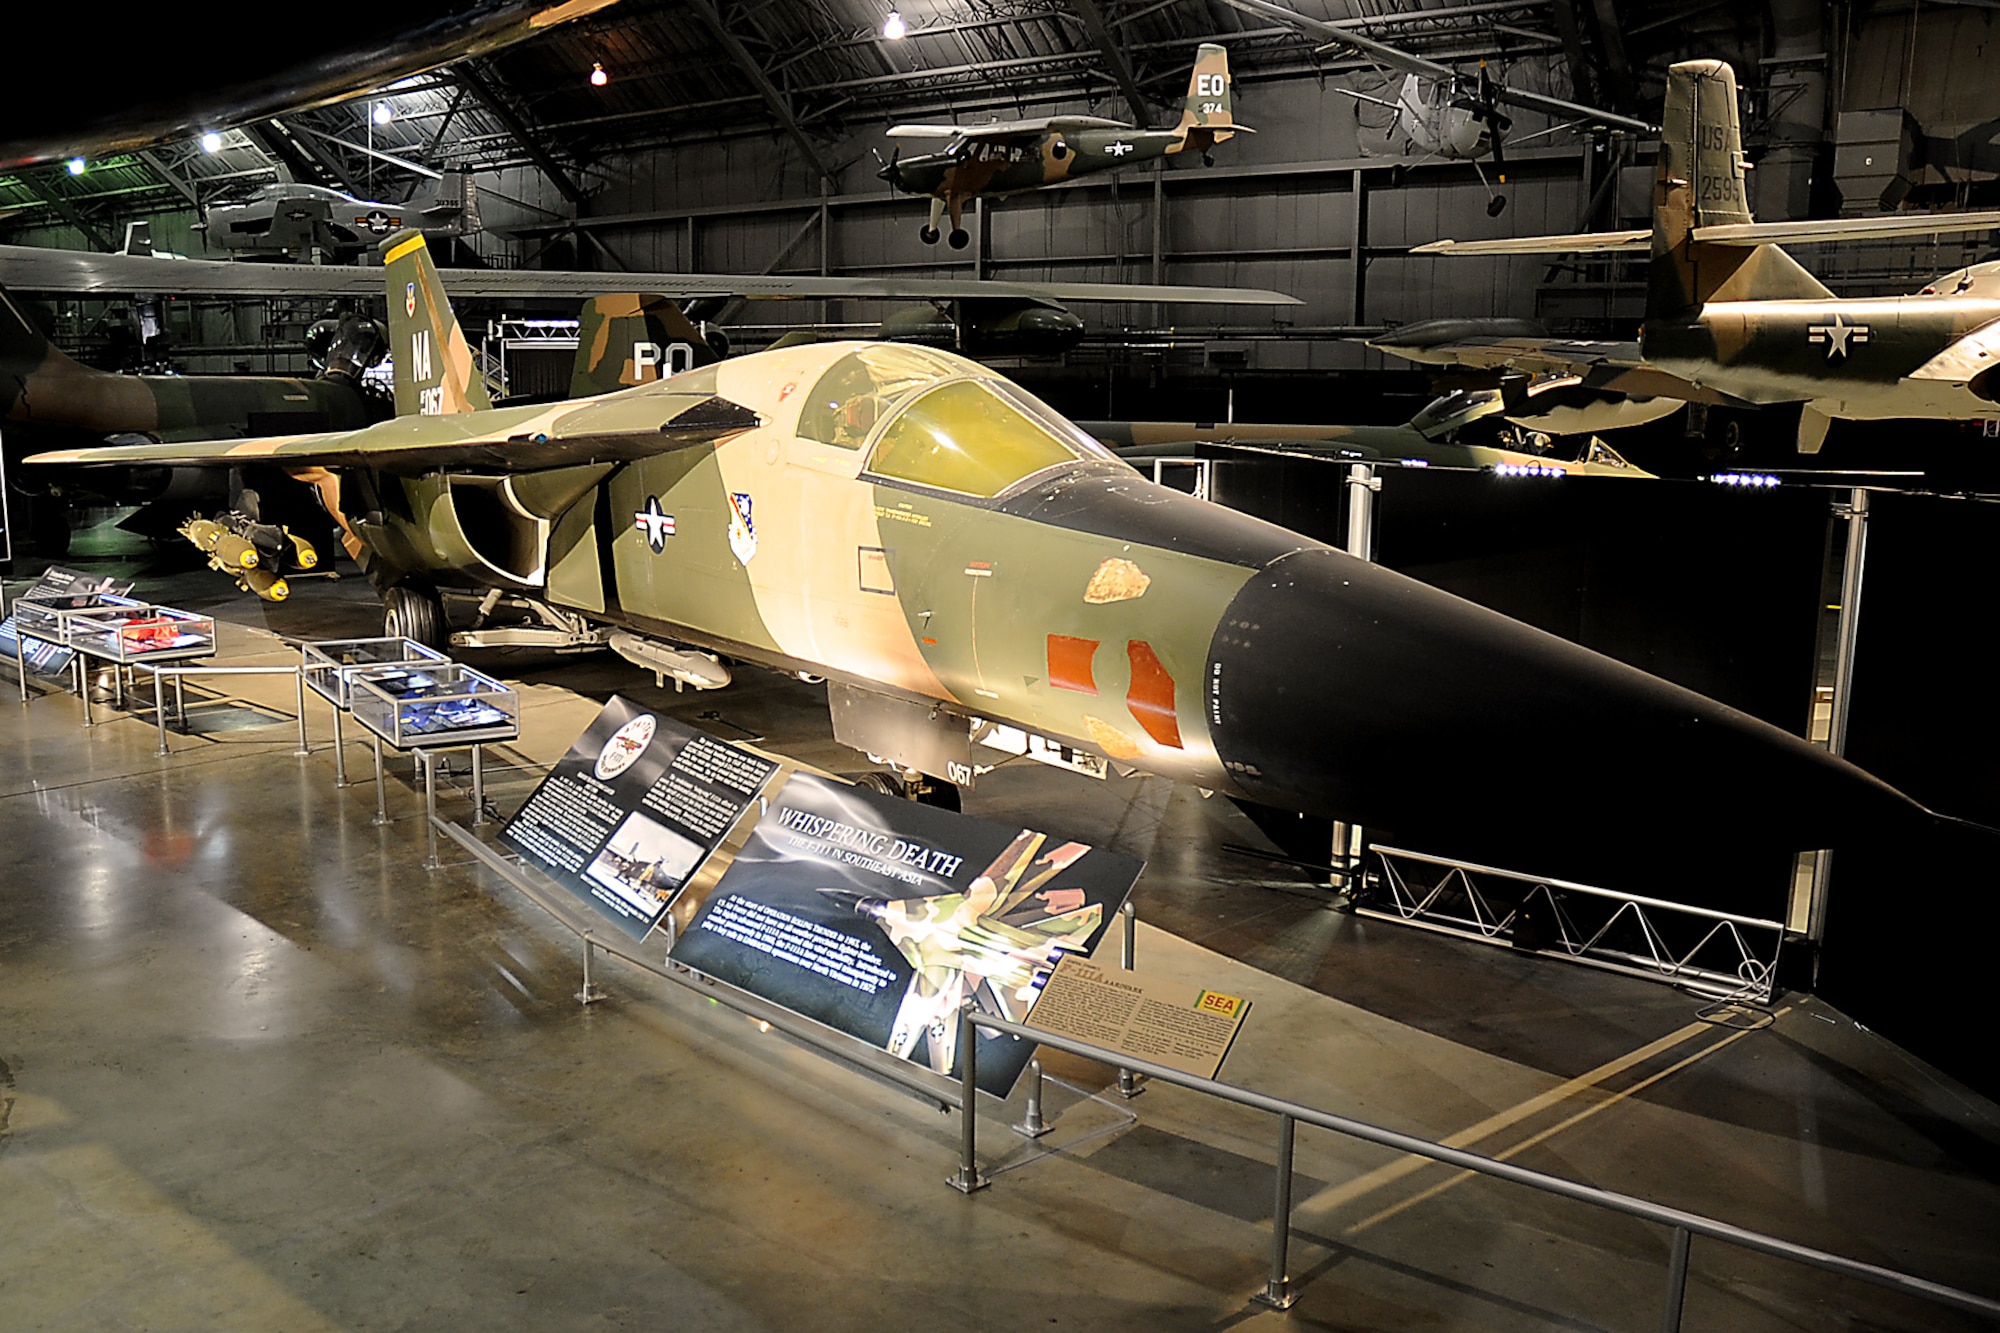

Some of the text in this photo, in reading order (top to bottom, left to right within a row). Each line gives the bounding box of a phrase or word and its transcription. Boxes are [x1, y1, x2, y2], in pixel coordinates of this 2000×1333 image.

[1198, 74, 1224, 96] EO
[1203, 103, 1222, 114] 374
[412, 330, 431, 383] NA
[1212, 663, 1221, 725] DO NOT PAINT
[947, 760, 971, 784] 067
[777, 807, 963, 878] WHISPERING DEATH
[788, 836, 925, 886] THE F-111 IN SOUTHEAST ASIA
[1060, 964, 1103, 983] F-111A
[1204, 995, 1233, 1010] SEA
